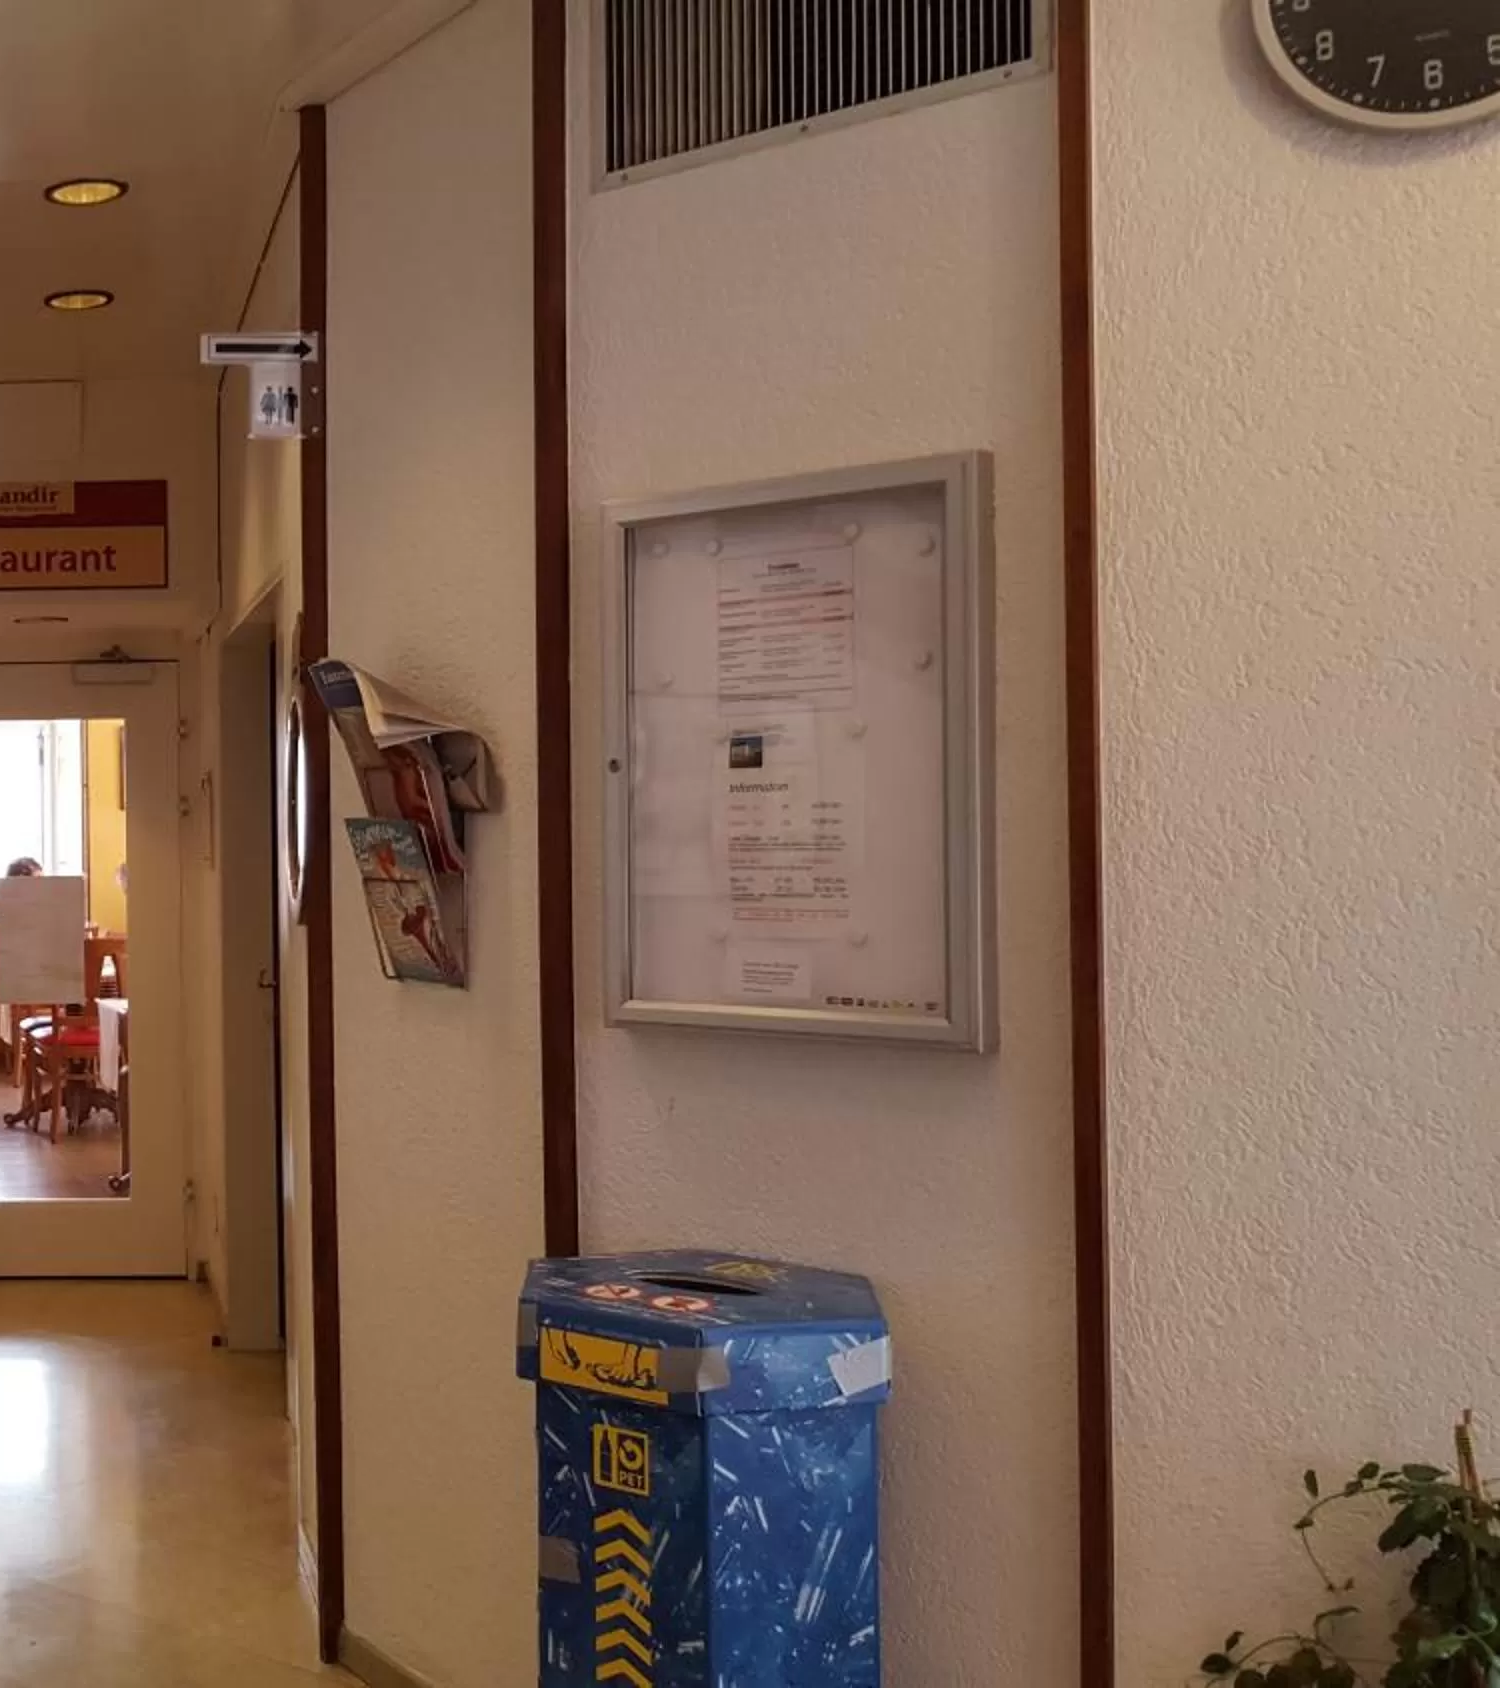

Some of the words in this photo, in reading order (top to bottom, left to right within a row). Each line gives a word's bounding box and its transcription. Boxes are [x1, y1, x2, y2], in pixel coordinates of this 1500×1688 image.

[1315, 29, 1334, 61] 8
[1366, 54, 1386, 88] 7
[619, 1471, 645, 1489] PET
